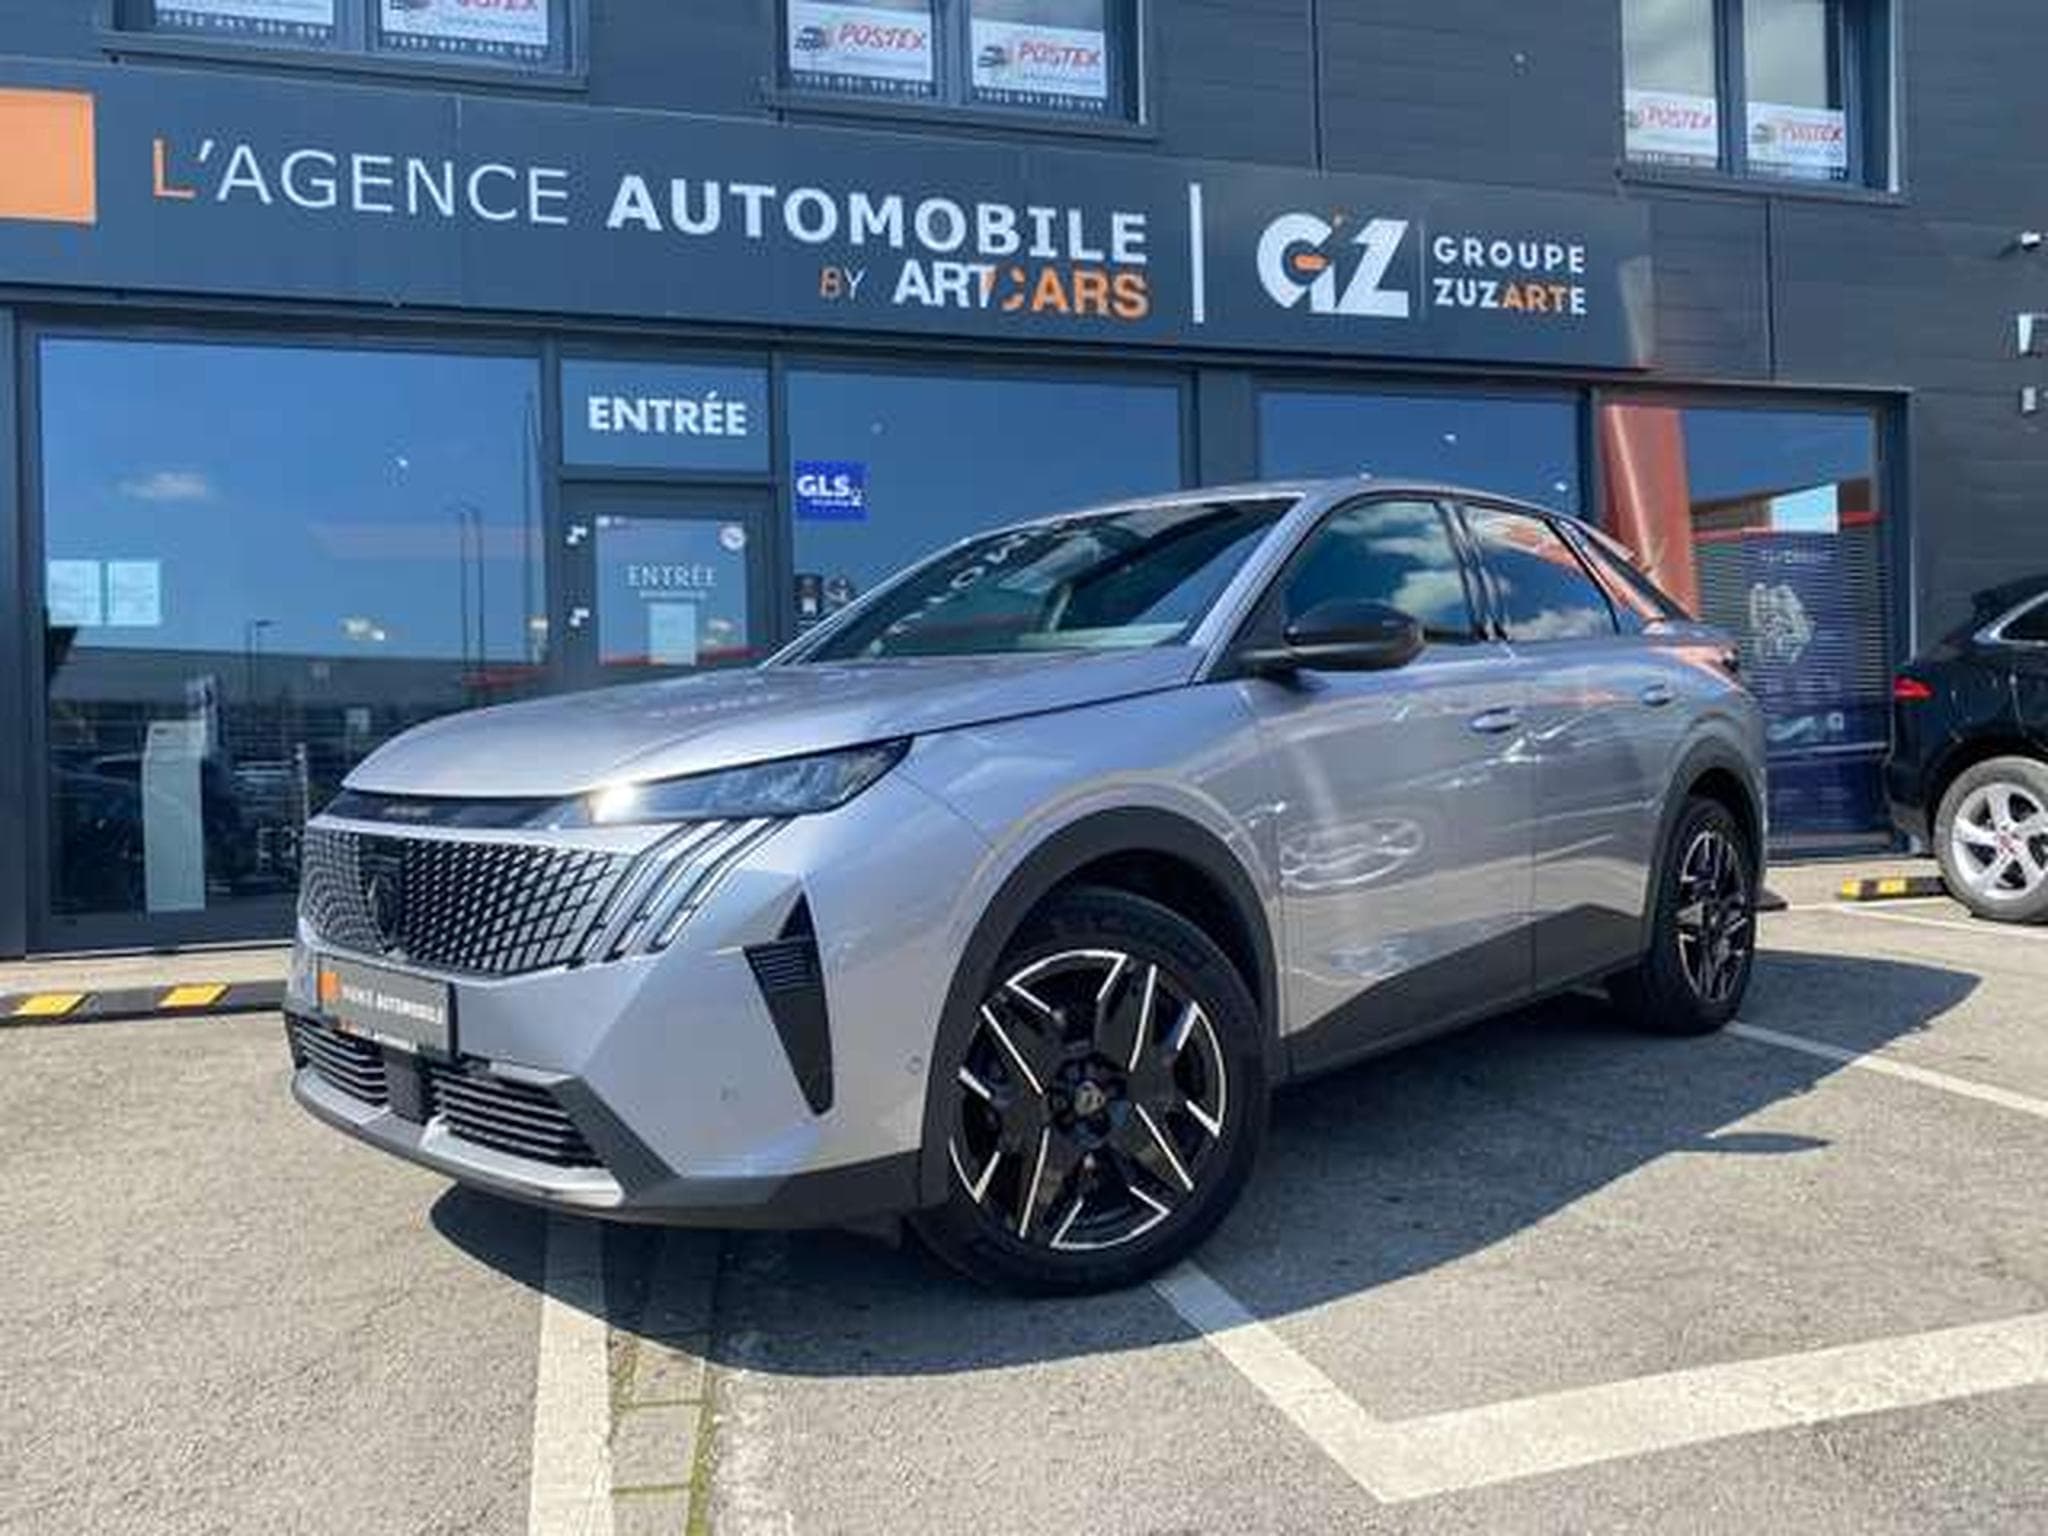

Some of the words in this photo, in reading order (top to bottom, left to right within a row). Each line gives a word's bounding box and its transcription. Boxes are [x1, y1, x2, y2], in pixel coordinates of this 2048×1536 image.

[838, 23, 928, 49] POSTEX
[1019, 40, 1101, 66] POSTEX
[152, 138, 570, 225] L'AGENCE
[606, 174, 1148, 264] AUTOMOBILE
[1433, 235, 1586, 274] GROUPE
[820, 266, 866, 299] BY
[893, 259, 1151, 320] ARTCARS
[1433, 277, 1588, 315] ZUZARTE
[587, 390, 748, 437] ENTRÉE
[796, 474, 851, 497] GLS
[626, 562, 718, 588] ENTRÉE
